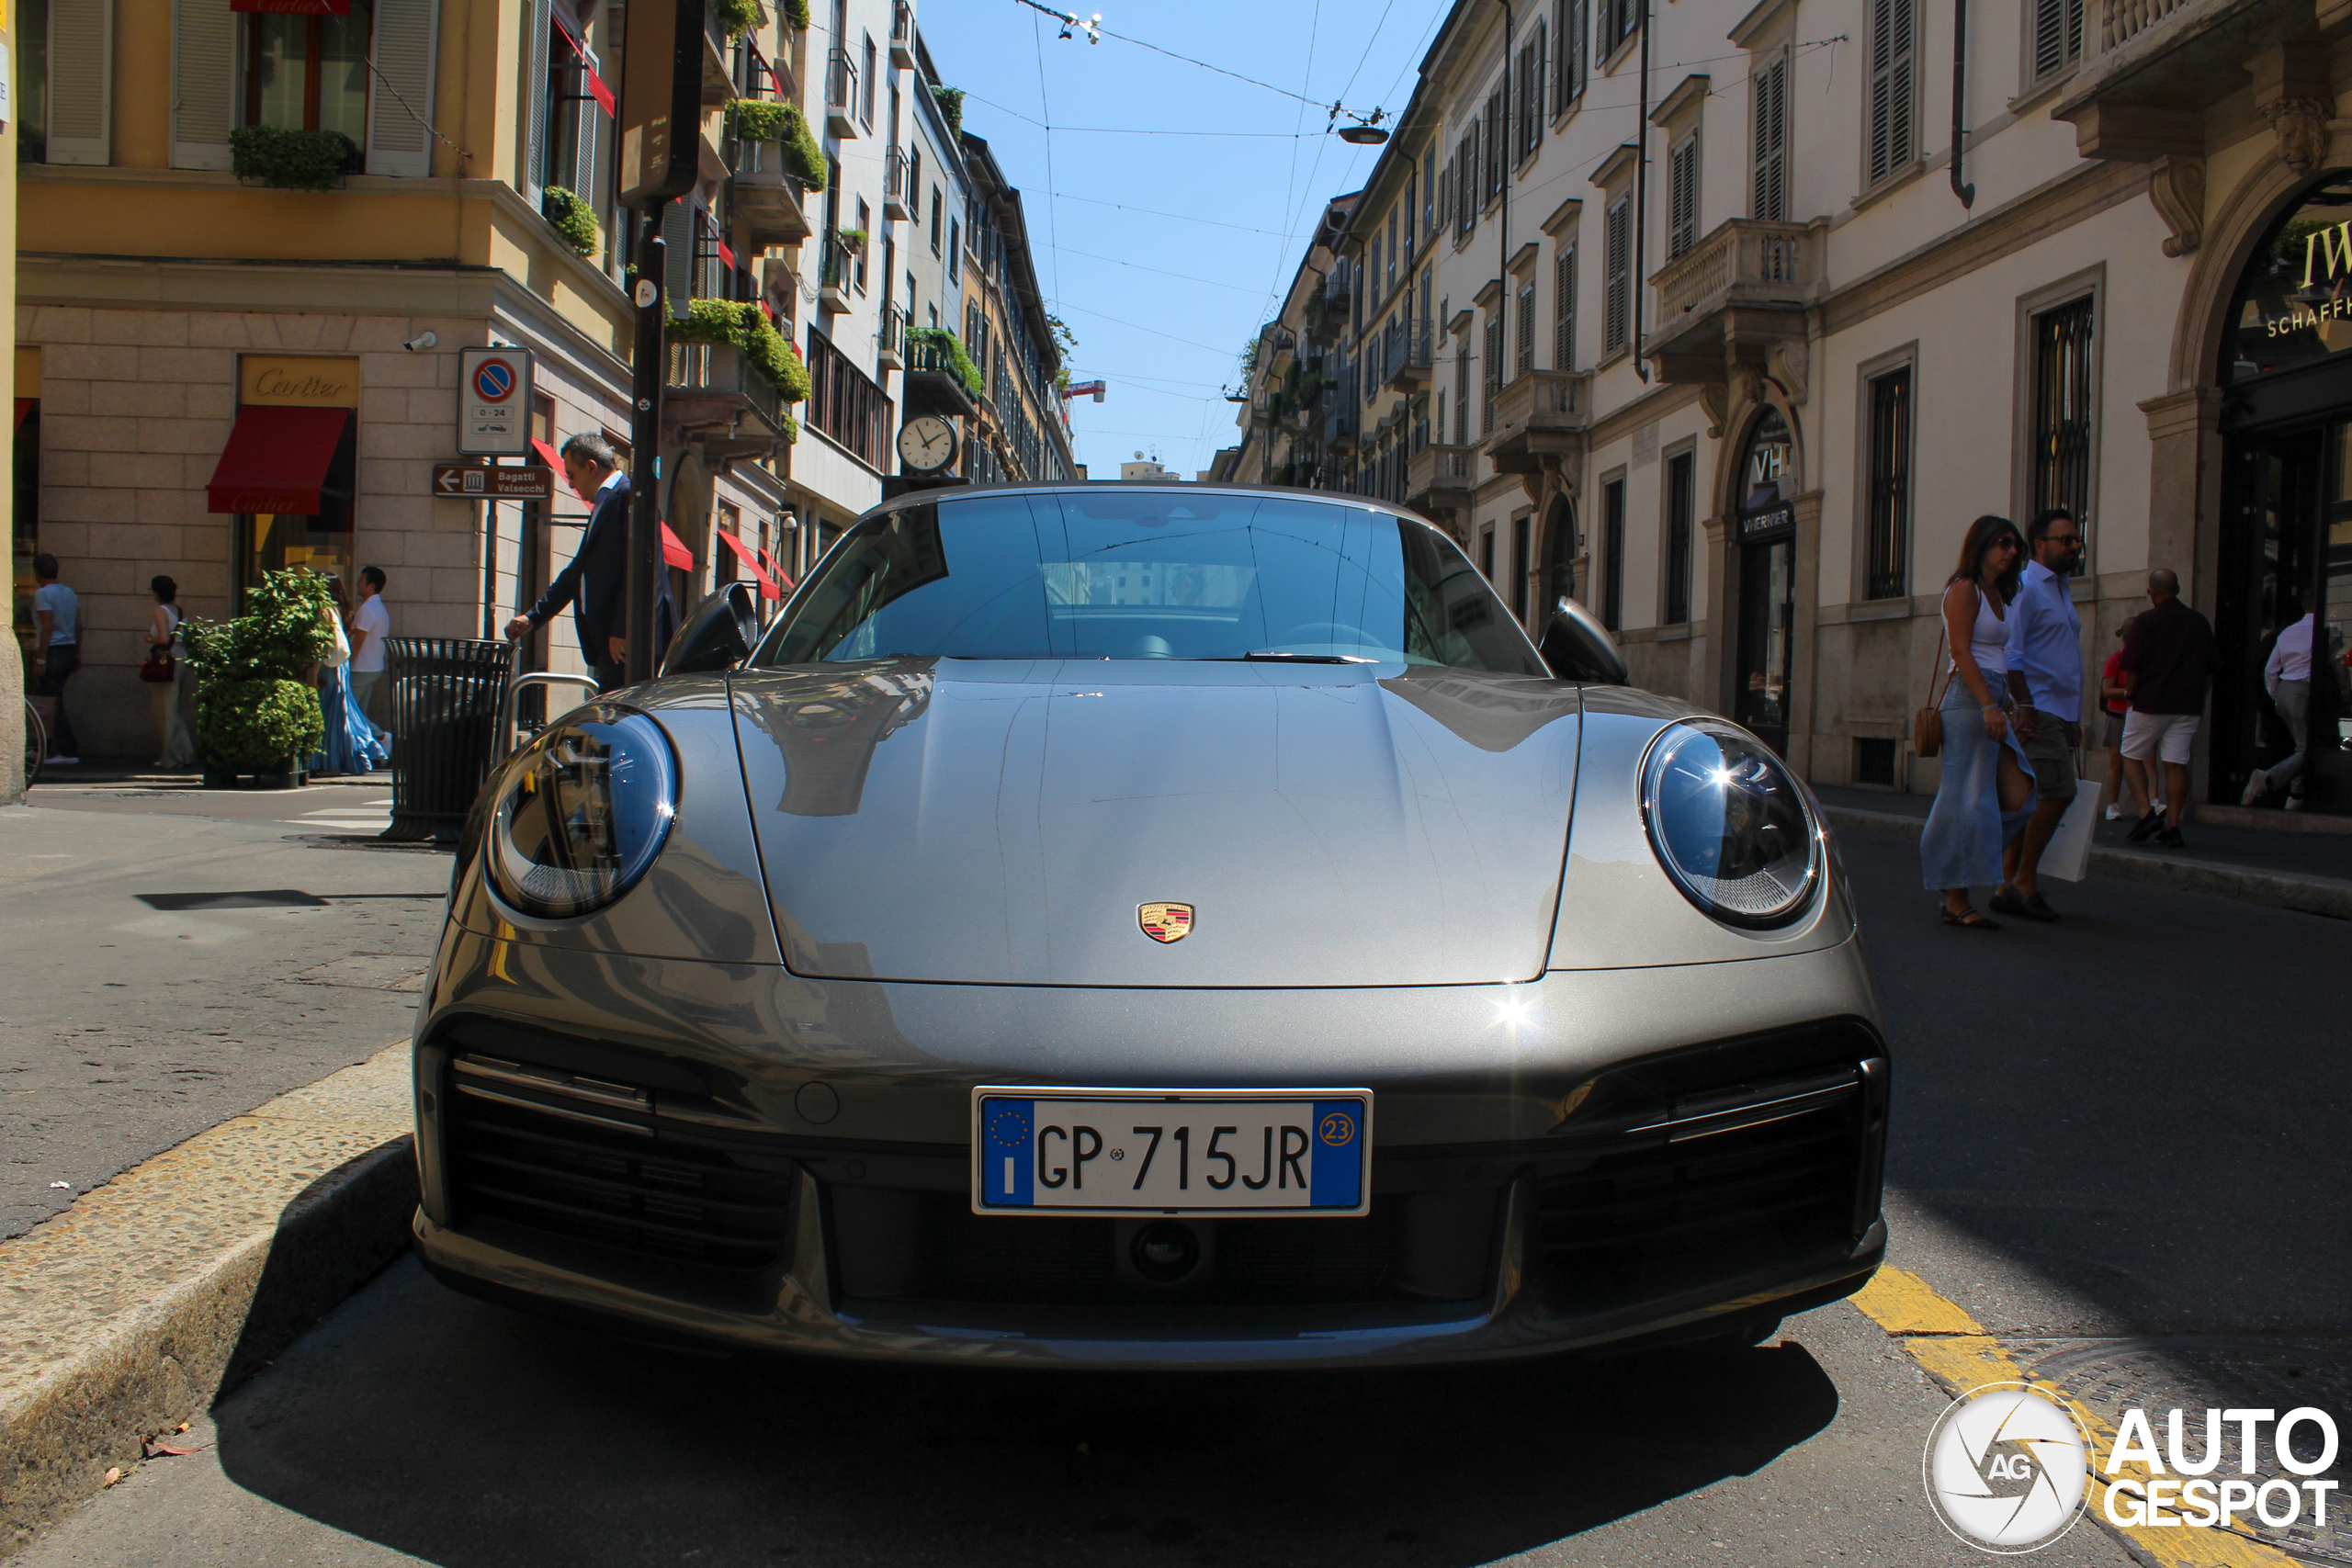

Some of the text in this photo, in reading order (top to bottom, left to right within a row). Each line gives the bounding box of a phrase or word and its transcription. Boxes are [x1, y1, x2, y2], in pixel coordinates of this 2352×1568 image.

[255, 368, 347, 397] Cartier
[493, 409, 505, 417] 24
[1754, 446, 1783, 481] VH
[498, 471, 536, 482] Bagatti
[497, 484, 545, 493] Valsecchi
[232, 491, 299, 512] Cartier
[1324, 1121, 1349, 1140] 23
[1038, 1125, 1102, 1189] GP
[1132, 1126, 1309, 1190] 715JR
